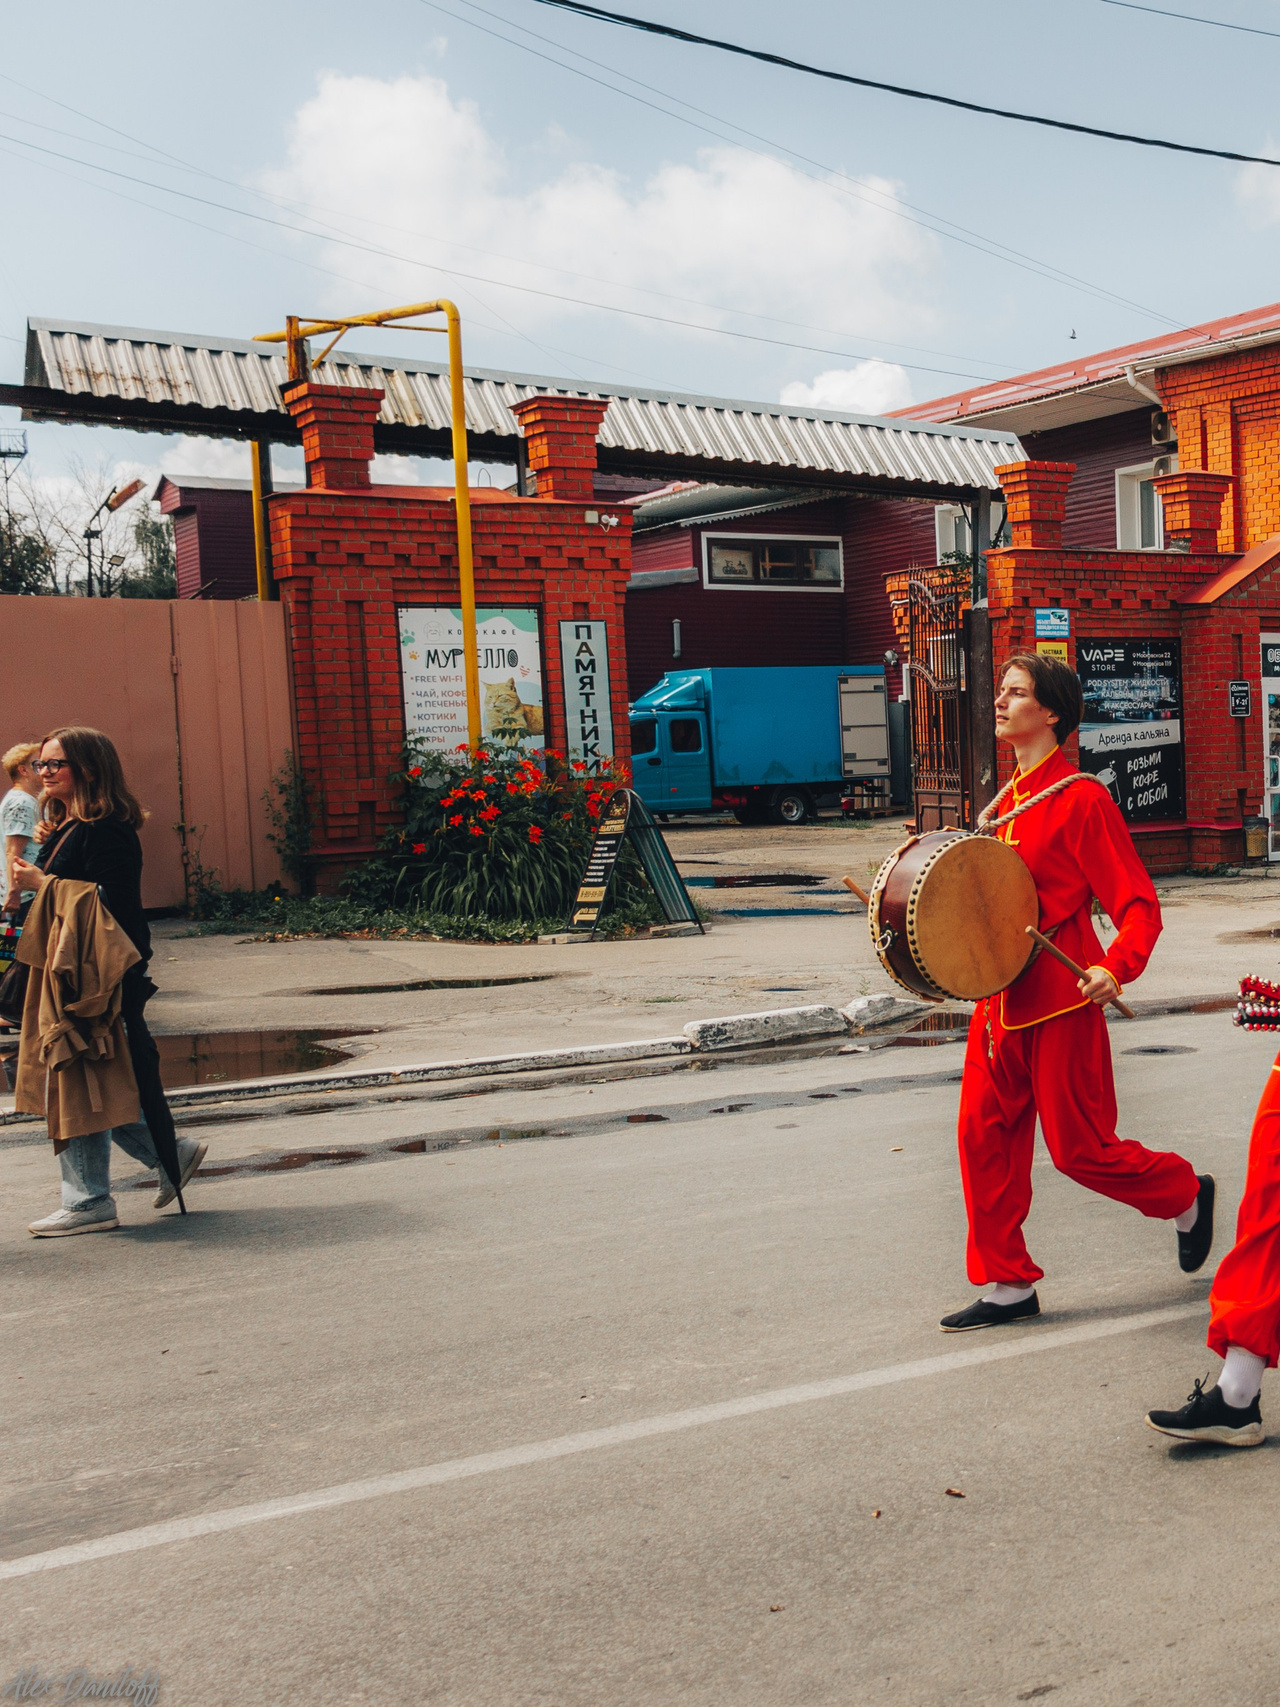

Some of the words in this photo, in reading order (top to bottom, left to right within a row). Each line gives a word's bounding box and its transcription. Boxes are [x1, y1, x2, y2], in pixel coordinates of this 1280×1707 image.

[426, 648, 518, 669] МУРЕЛЛО
[1081, 649, 1125, 661] VAPE
[415, 675, 437, 683] FREE
[1087, 679, 1102, 687] POD
[1130, 679, 1169, 687] ЖИДКОСТИ
[415, 689, 440, 699] ЧАЙ,
[441, 690, 467, 698] КОФЕ
[574, 624, 601, 774] ПАМЯТНИКИ
[417, 713, 457, 721] КОТИКИ
[418, 725, 469, 733] НАСТОЛЬН
[1098, 732, 1132, 746] Аренда
[1133, 728, 1170, 740] кальяна
[1127, 750, 1162, 774] ВОЗЬМИ
[1132, 770, 1159, 789] КОФЕ
[1137, 782, 1168, 807] СОБОЙ
